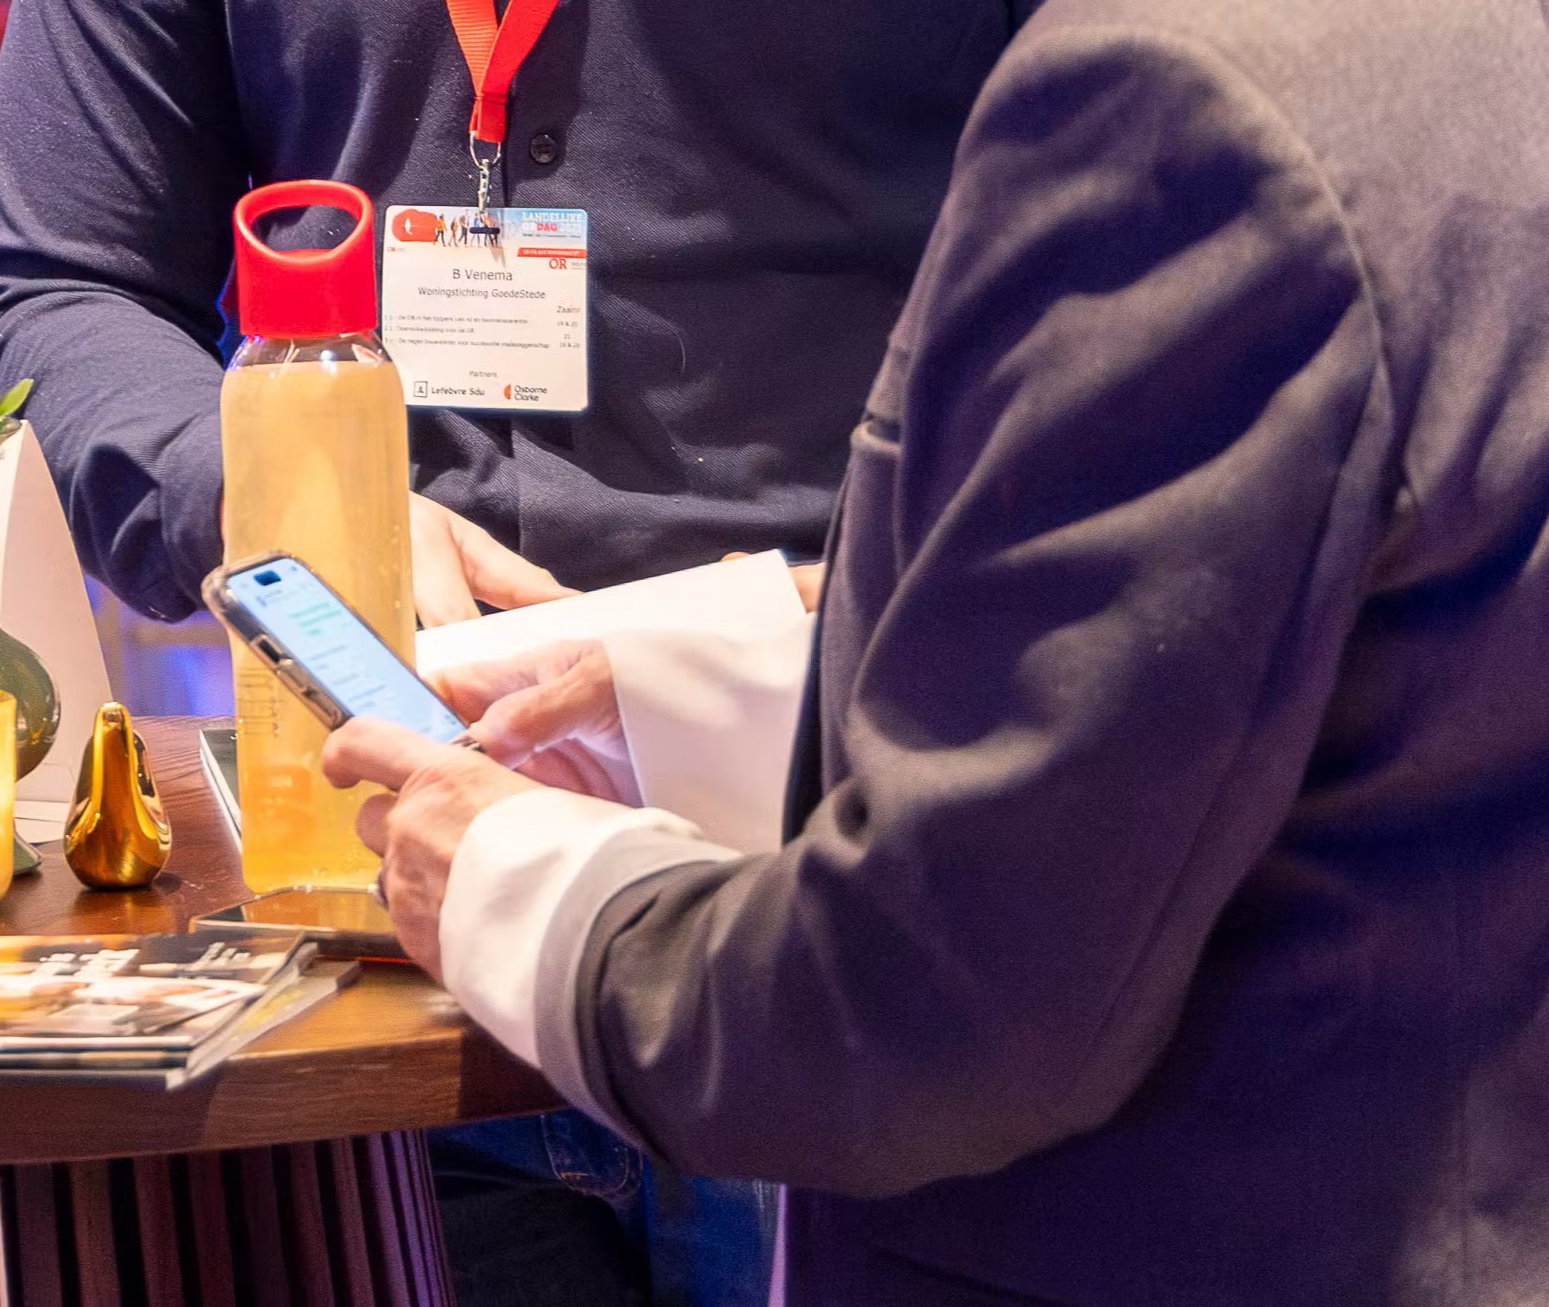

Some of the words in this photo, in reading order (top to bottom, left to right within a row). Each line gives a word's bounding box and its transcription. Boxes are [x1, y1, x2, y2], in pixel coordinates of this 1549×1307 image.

[549, 258, 567, 269] OR
[453, 269, 461, 280] B
[465, 269, 513, 281] Venema
[418, 287, 489, 299] Woningstichting
[491, 289, 546, 299] GoedeStede
[431, 387, 467, 395] Lefebvre
[469, 387, 485, 396] Sdu
[514, 384, 547, 394] Osborne
[514, 393, 540, 401] Clarke
